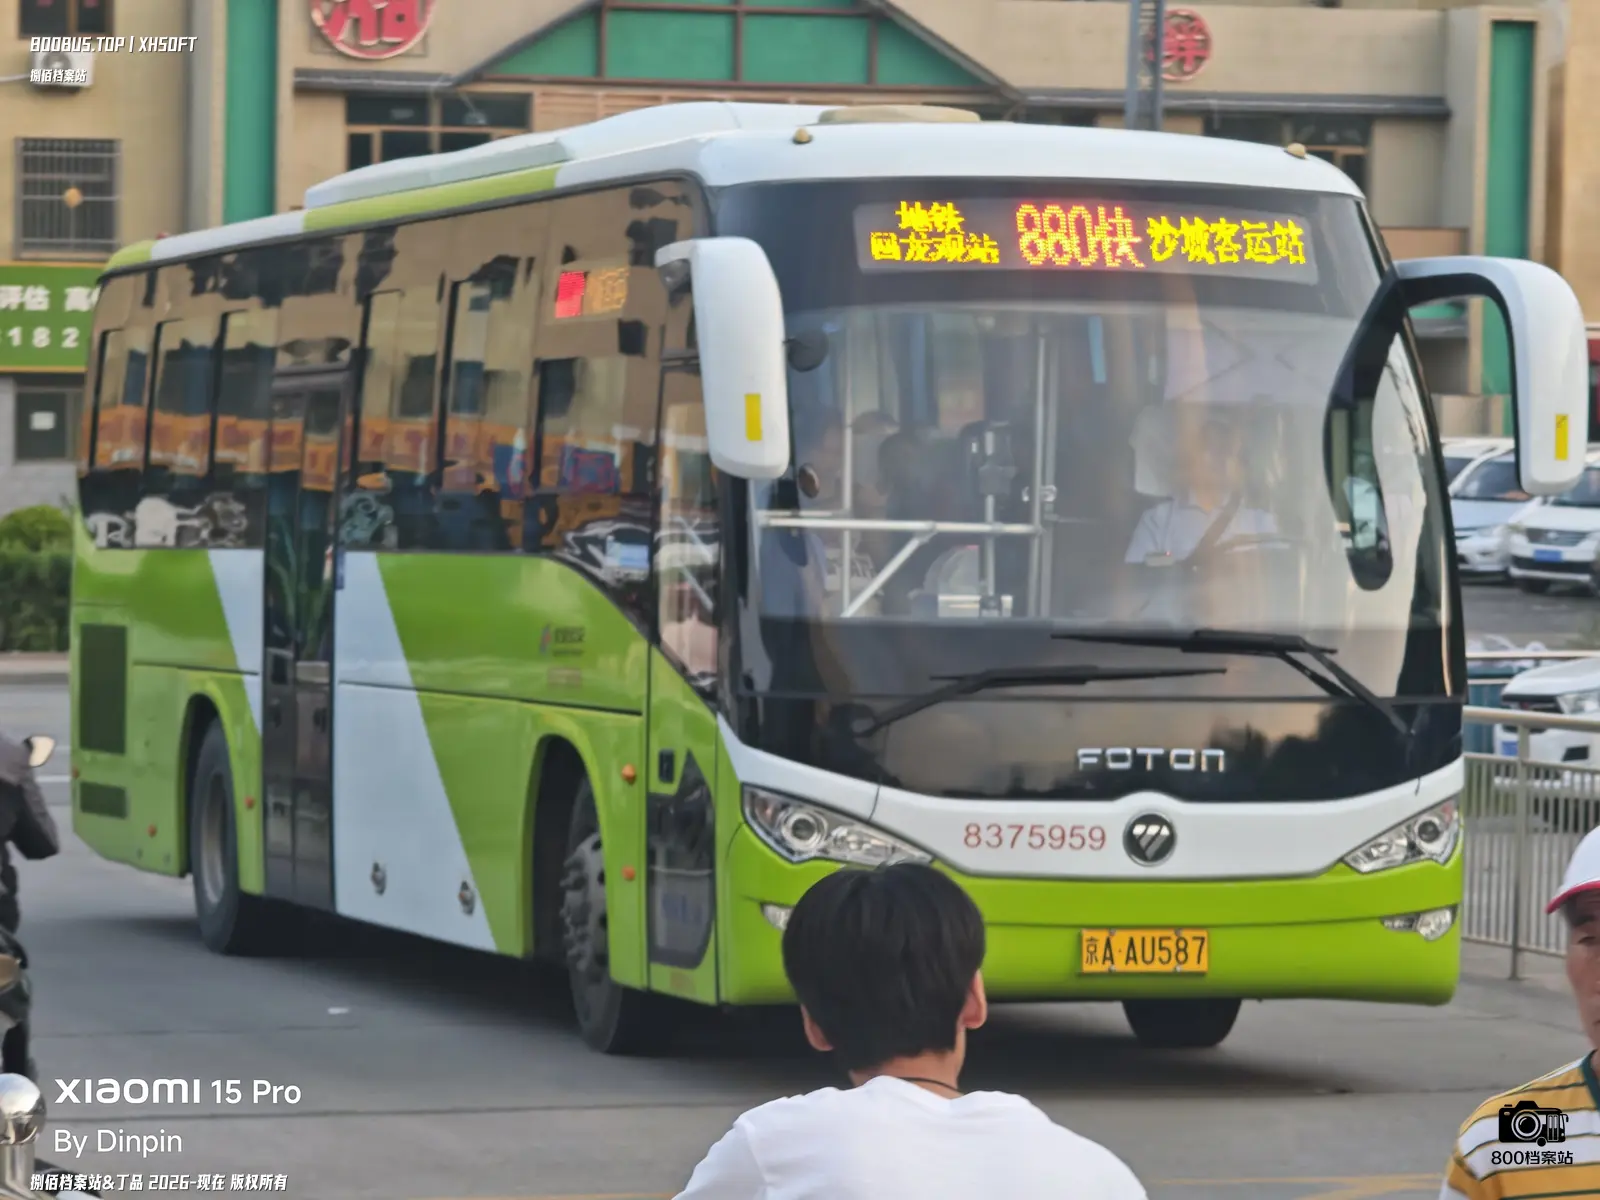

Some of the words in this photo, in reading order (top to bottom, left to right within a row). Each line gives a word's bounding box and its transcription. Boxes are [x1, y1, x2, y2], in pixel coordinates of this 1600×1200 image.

[895, 201, 965, 231] 地铁
[870, 231, 1000, 264] 回龙观站
[1015, 203, 1144, 268] 880快
[1147, 216, 1306, 265] 沙城客运站
[1077, 747, 1225, 772] FOTON
[963, 823, 1107, 851] 8375959
